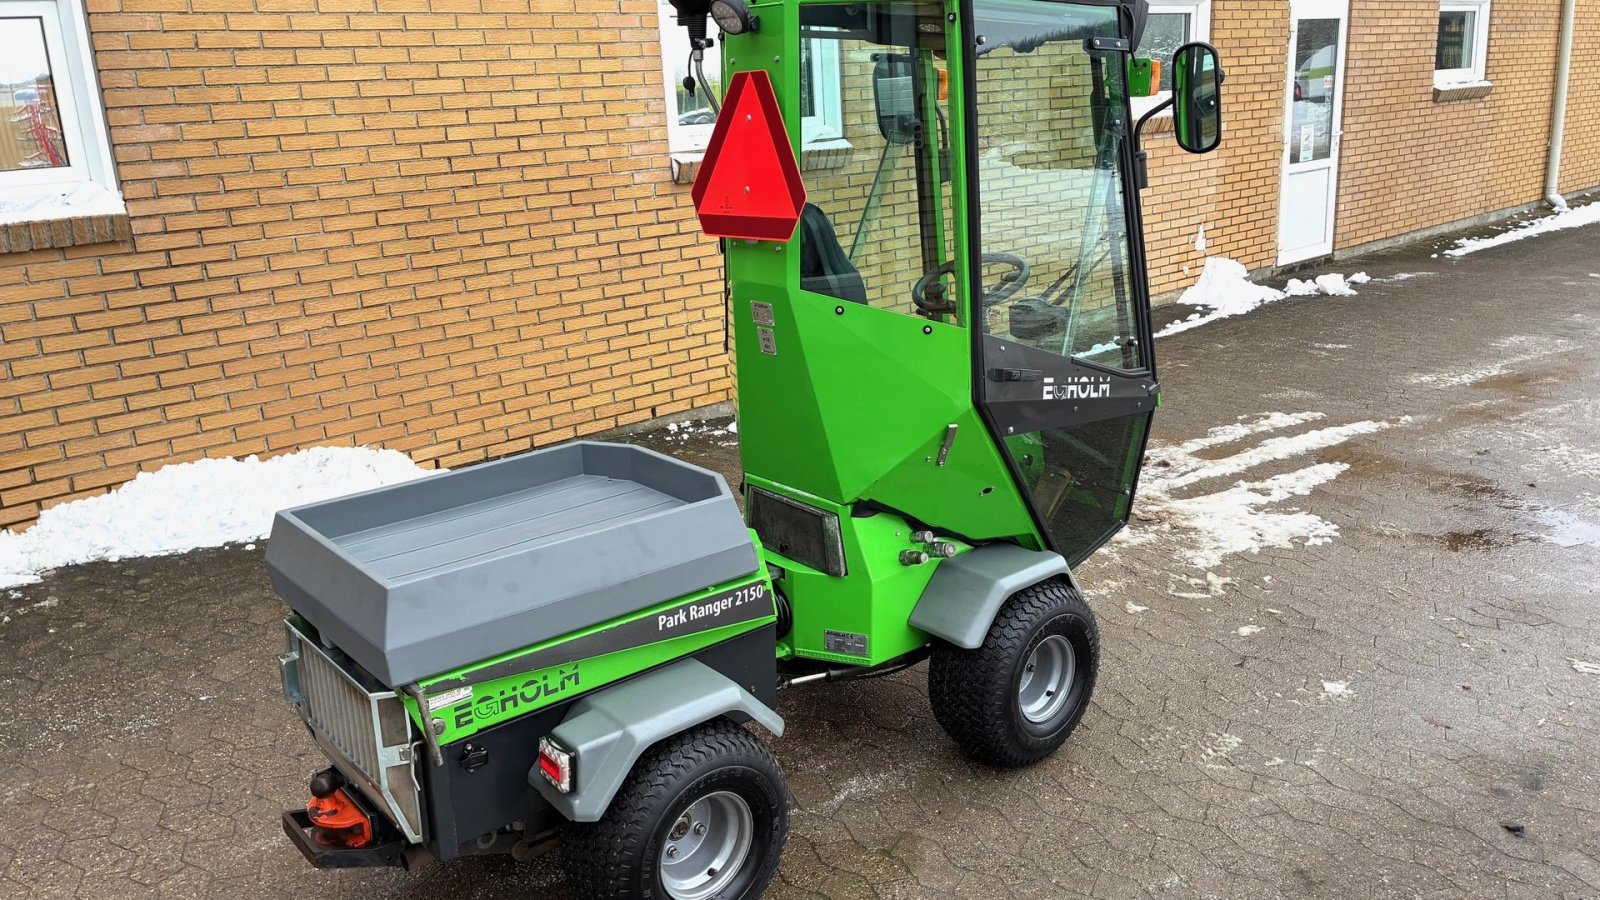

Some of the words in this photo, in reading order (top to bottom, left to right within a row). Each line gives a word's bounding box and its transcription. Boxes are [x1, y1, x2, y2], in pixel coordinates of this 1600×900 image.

[1043, 376, 1111, 400] EGHOLM
[658, 609, 688, 631] Park
[690, 596, 734, 617] Ranger
[735, 584, 764, 606] 2150
[453, 664, 580, 729] EGHOLM
